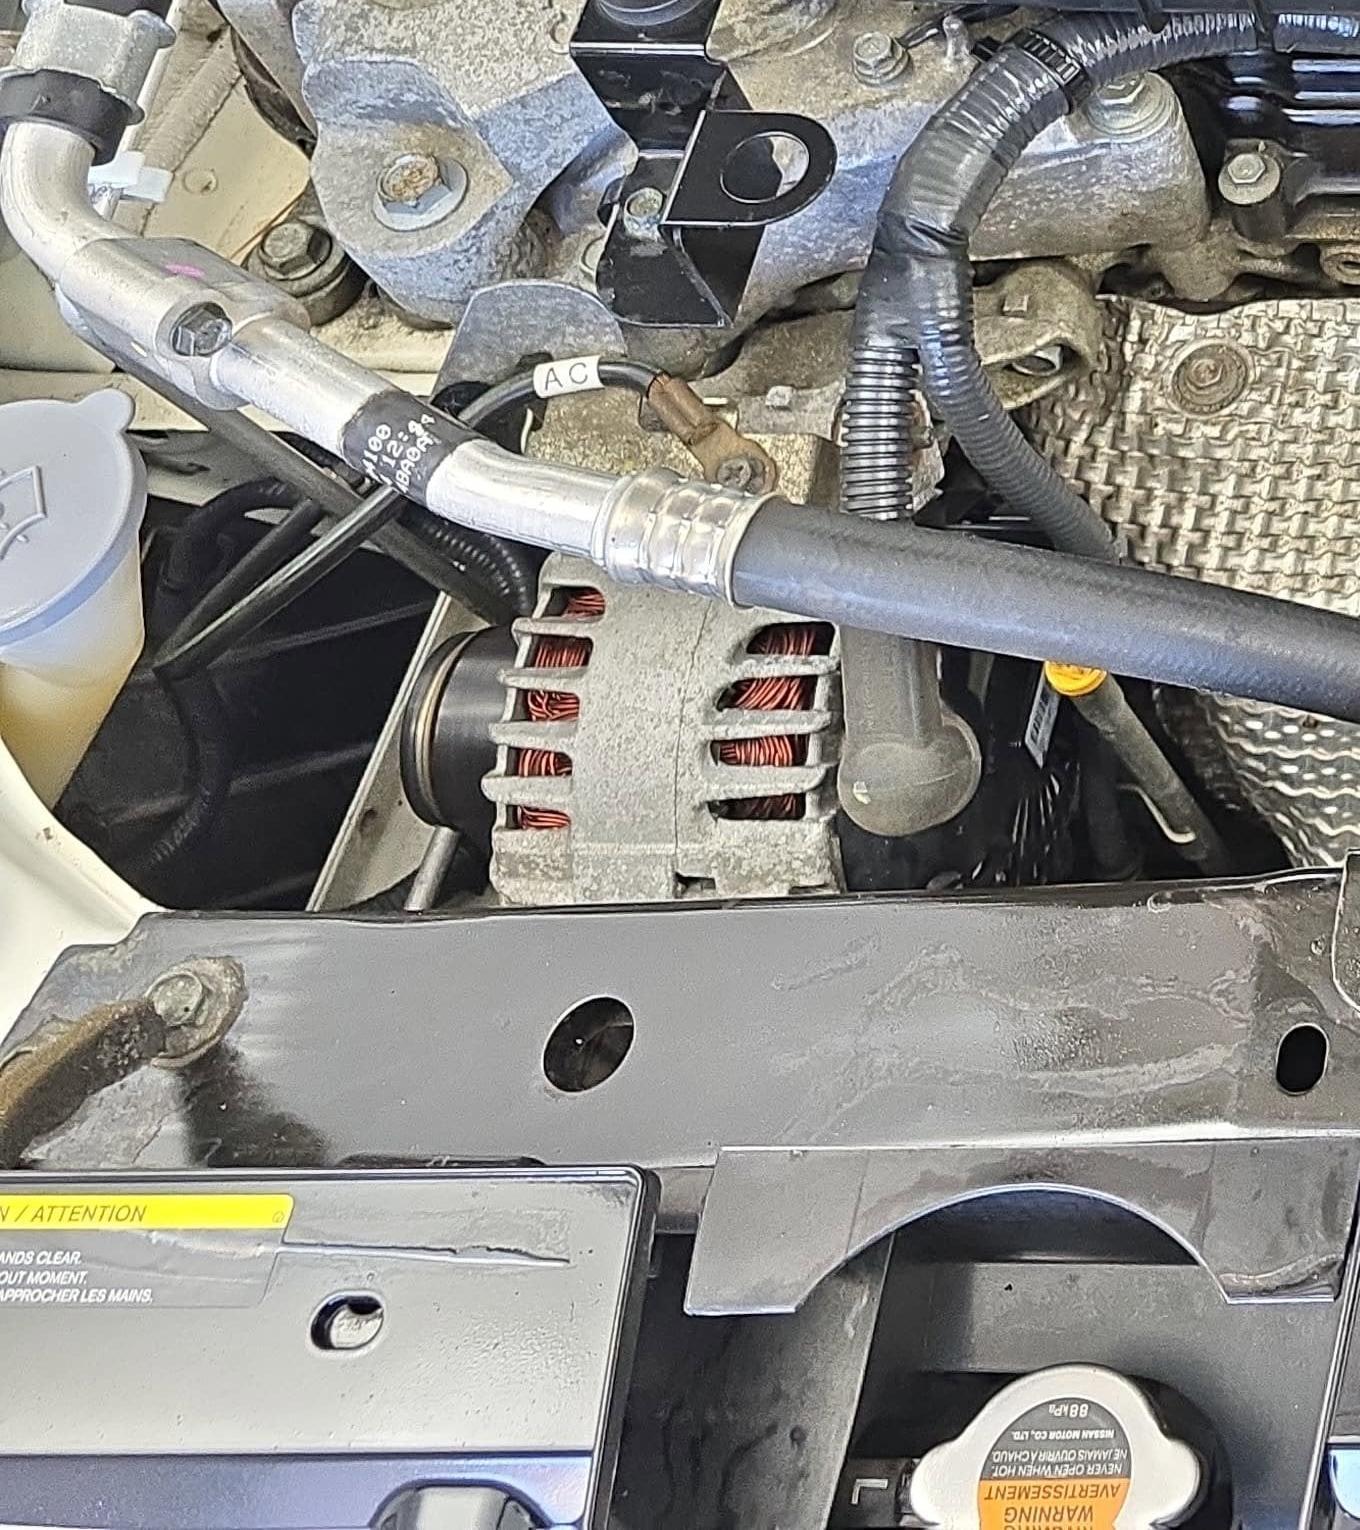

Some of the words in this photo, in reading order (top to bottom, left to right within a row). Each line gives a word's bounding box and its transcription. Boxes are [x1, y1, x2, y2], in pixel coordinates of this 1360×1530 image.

[30, 1205, 148, 1222] ATTENTION
[0, 1250, 34, 1266] ANDS
[36, 1250, 82, 1266] CLEAR.
[26, 1270, 87, 1286] MOMENT.
[80, 1289, 106, 1303] LES
[107, 1289, 153, 1303] MAINS.
[1069, 1403, 1089, 1418] 88
[1049, 1429, 1081, 1440] MOTOR
[1081, 1429, 1115, 1439] NISSAN
[1077, 1448, 1113, 1461] JAMAIS
[1113, 1448, 1128, 1461] NE
[1018, 1464, 1053, 1477] WHEN
[1055, 1463, 1085, 1477] OPEN
[1088, 1463, 1123, 1475] NEVER
[984, 1483, 1121, 1500] AVERTISSEMENT
[1004, 1505, 1093, 1523] WARNING
